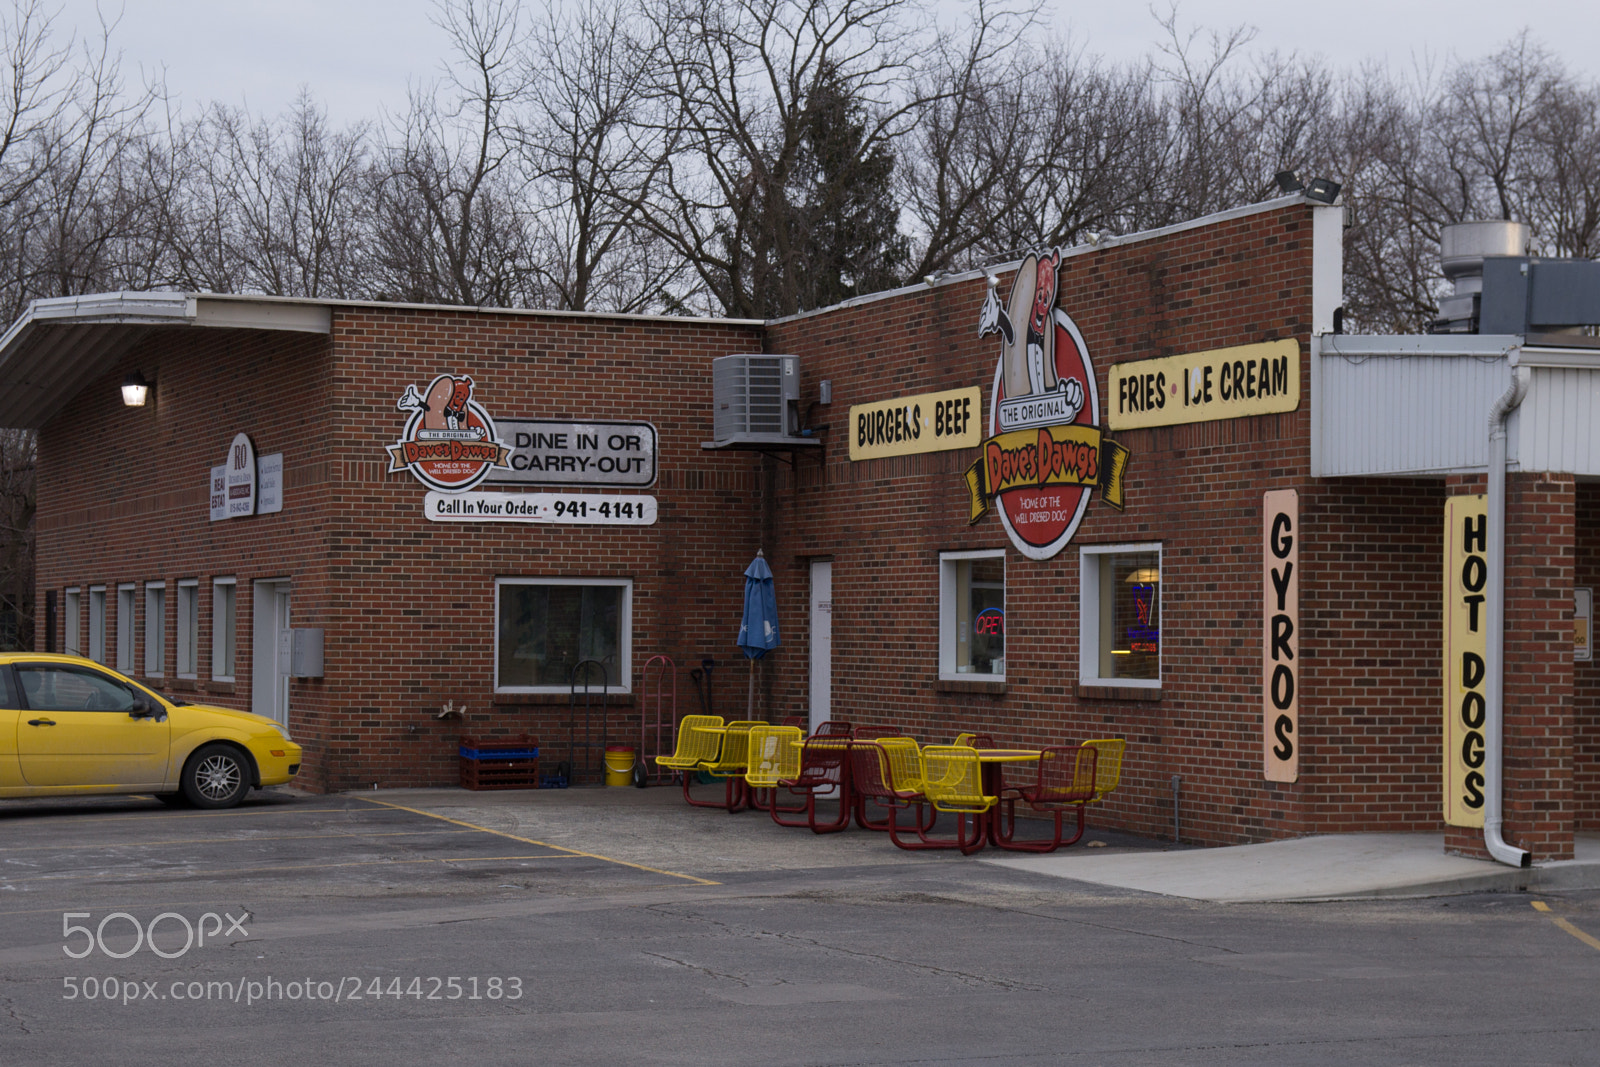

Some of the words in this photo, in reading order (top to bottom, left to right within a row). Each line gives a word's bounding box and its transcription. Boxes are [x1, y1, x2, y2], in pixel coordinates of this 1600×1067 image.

[1119, 371, 1166, 414] FRIES
[1220, 355, 1288, 401] CREAM
[858, 403, 921, 447] BURGERS
[935, 397, 971, 437] BEEF
[1003, 407, 1018, 422] THE
[1021, 400, 1065, 420] ORIGINAL
[405, 441, 450, 463] Dave's
[450, 440, 497, 462] Dawgs
[515, 432, 568, 449] DINE
[577, 434, 598, 450] IN
[607, 434, 641, 451] OR
[234, 443, 247, 470] RO
[511, 454, 645, 473] CARRY-OUT
[986, 441, 1038, 496] Dave's
[1037, 427, 1098, 484] Dawgs
[437, 499, 460, 514] Call
[463, 500, 474, 514] In
[476, 499, 502, 514] Your
[505, 500, 539, 515] Order
[553, 500, 644, 519] 941-4141
[1039, 497, 1048, 508] OF
[1048, 495, 1061, 508] THE
[1014, 512, 1028, 524] WELL
[1462, 513, 1487, 633] HOT
[976, 615, 1005, 635] OPEN
[1270, 511, 1295, 761] GYROS
[1461, 651, 1486, 809] DOGS
